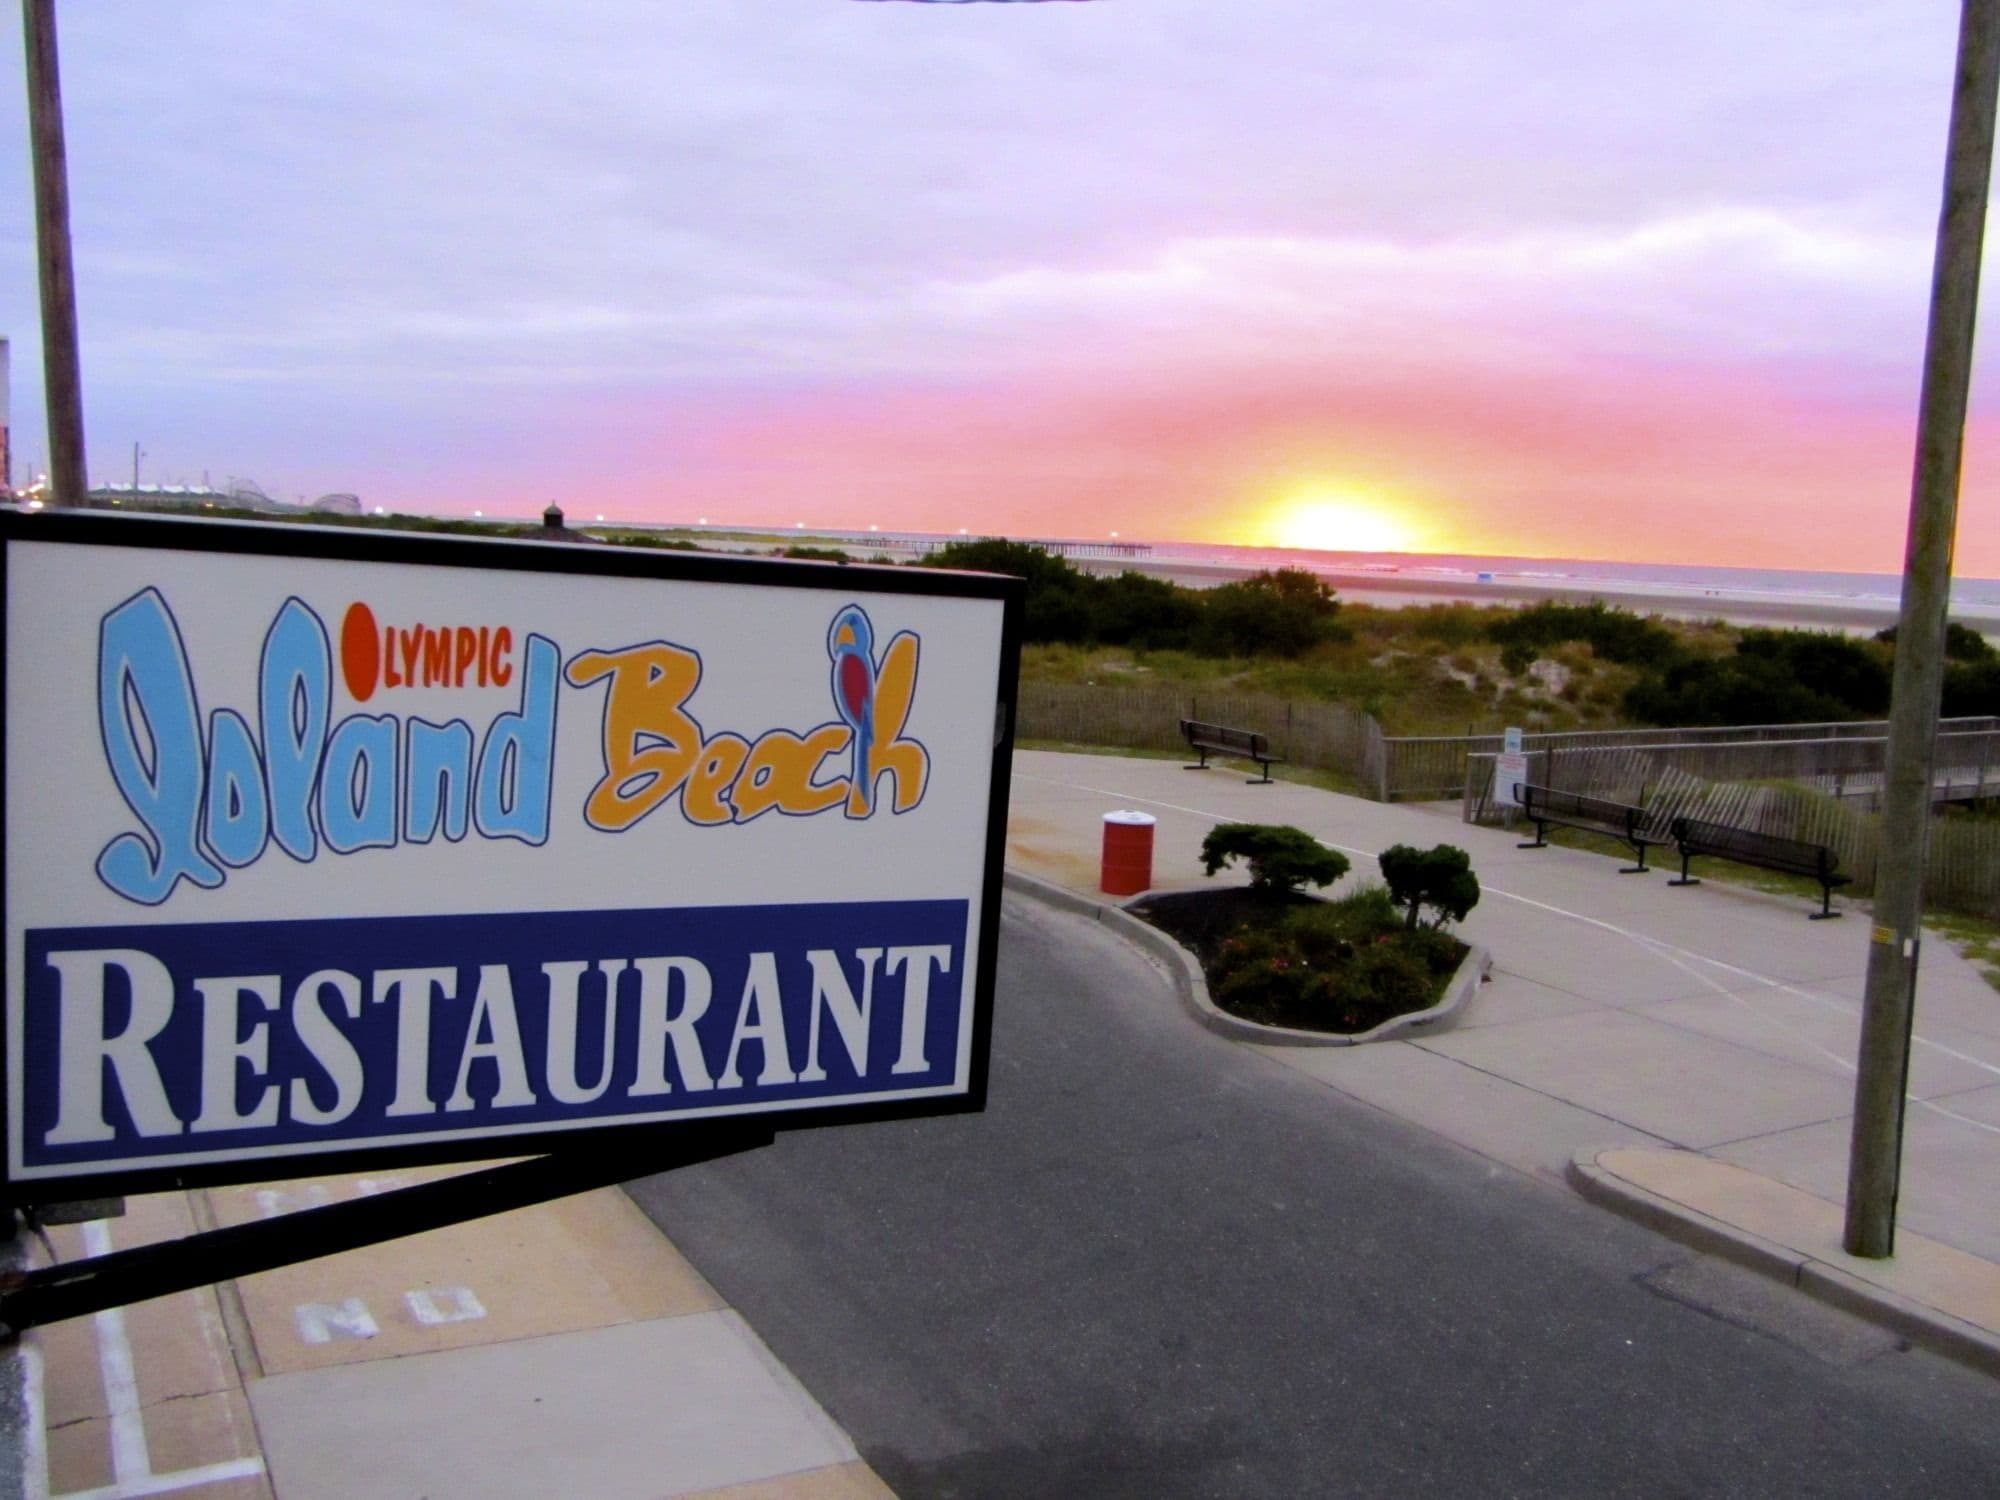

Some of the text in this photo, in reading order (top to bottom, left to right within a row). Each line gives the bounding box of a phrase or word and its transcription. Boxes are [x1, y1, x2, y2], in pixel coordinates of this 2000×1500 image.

[341, 602, 512, 702] OLYMPIC
[564, 629, 930, 832] Beach
[44, 944, 952, 1146] RESTAURANT
